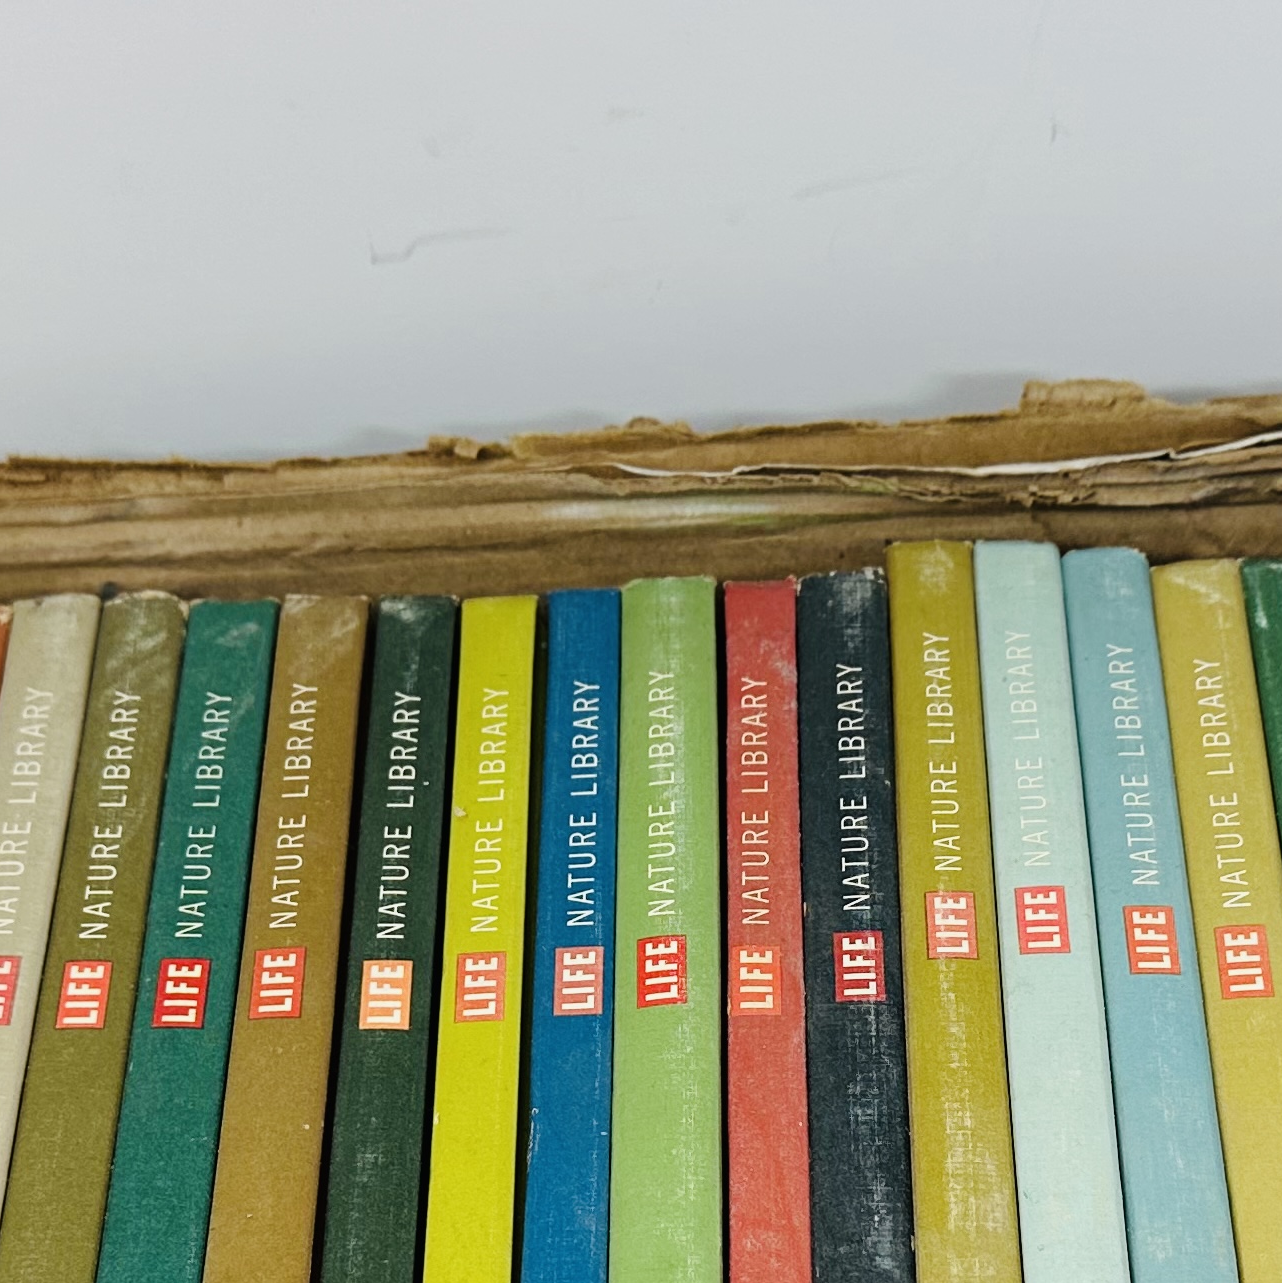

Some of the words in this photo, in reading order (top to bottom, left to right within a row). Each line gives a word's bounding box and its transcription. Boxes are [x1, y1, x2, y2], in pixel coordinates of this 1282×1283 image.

[282, 682, 319, 798] LIBRARY
[570, 681, 601, 796] LIBRARY
[648, 671, 675, 787] LIBRARY
[741, 676, 768, 792] LIBRARY
[836, 664, 867, 779] LIBRARY
[923, 632, 956, 744] LIBRARY
[1006, 629, 1045, 741] LIBRARY
[1107, 643, 1148, 755] LIBRARY
[1193, 659, 1235, 775] LIBRARY
[10, 686, 55, 803] LIBRARY
[100, 690, 141, 807] LIBRARY
[193, 691, 232, 807] LIBRARY
[387, 691, 421, 808] LIBRARY
[478, 688, 509, 801] LIBRARY
[567, 811, 598, 926] NATURE
[648, 802, 676, 918] NATURE
[743, 810, 770, 924] NATURE
[842, 796, 868, 911] NATURE
[928, 761, 963, 871] NATURE
[1015, 758, 1051, 867] NATURE
[1116, 774, 1159, 885] NATURE
[1211, 792, 1251, 908] NATURE
[79, 823, 123, 939] NATURE
[176, 824, 216, 938] NATURE
[269, 813, 307, 928] NATURE
[377, 824, 413, 939] NATURE
[471, 818, 503, 932] NATURE
[935, 894, 969, 954] LIFE
[1024, 889, 1061, 949] LIFE
[65, 964, 109, 1024] LIFE
[161, 961, 203, 1024] LIFE
[258, 951, 302, 1014] LIFE
[367, 962, 407, 1024] LIFE
[464, 956, 502, 1018] LIFE
[561, 951, 598, 1011] LIFE
[645, 939, 678, 1001] LIFE
[739, 949, 773, 1010] LIFE
[842, 934, 877, 996] LIFE
[1130, 909, 1171, 970] LIFE
[1222, 929, 1265, 992] LIFE
